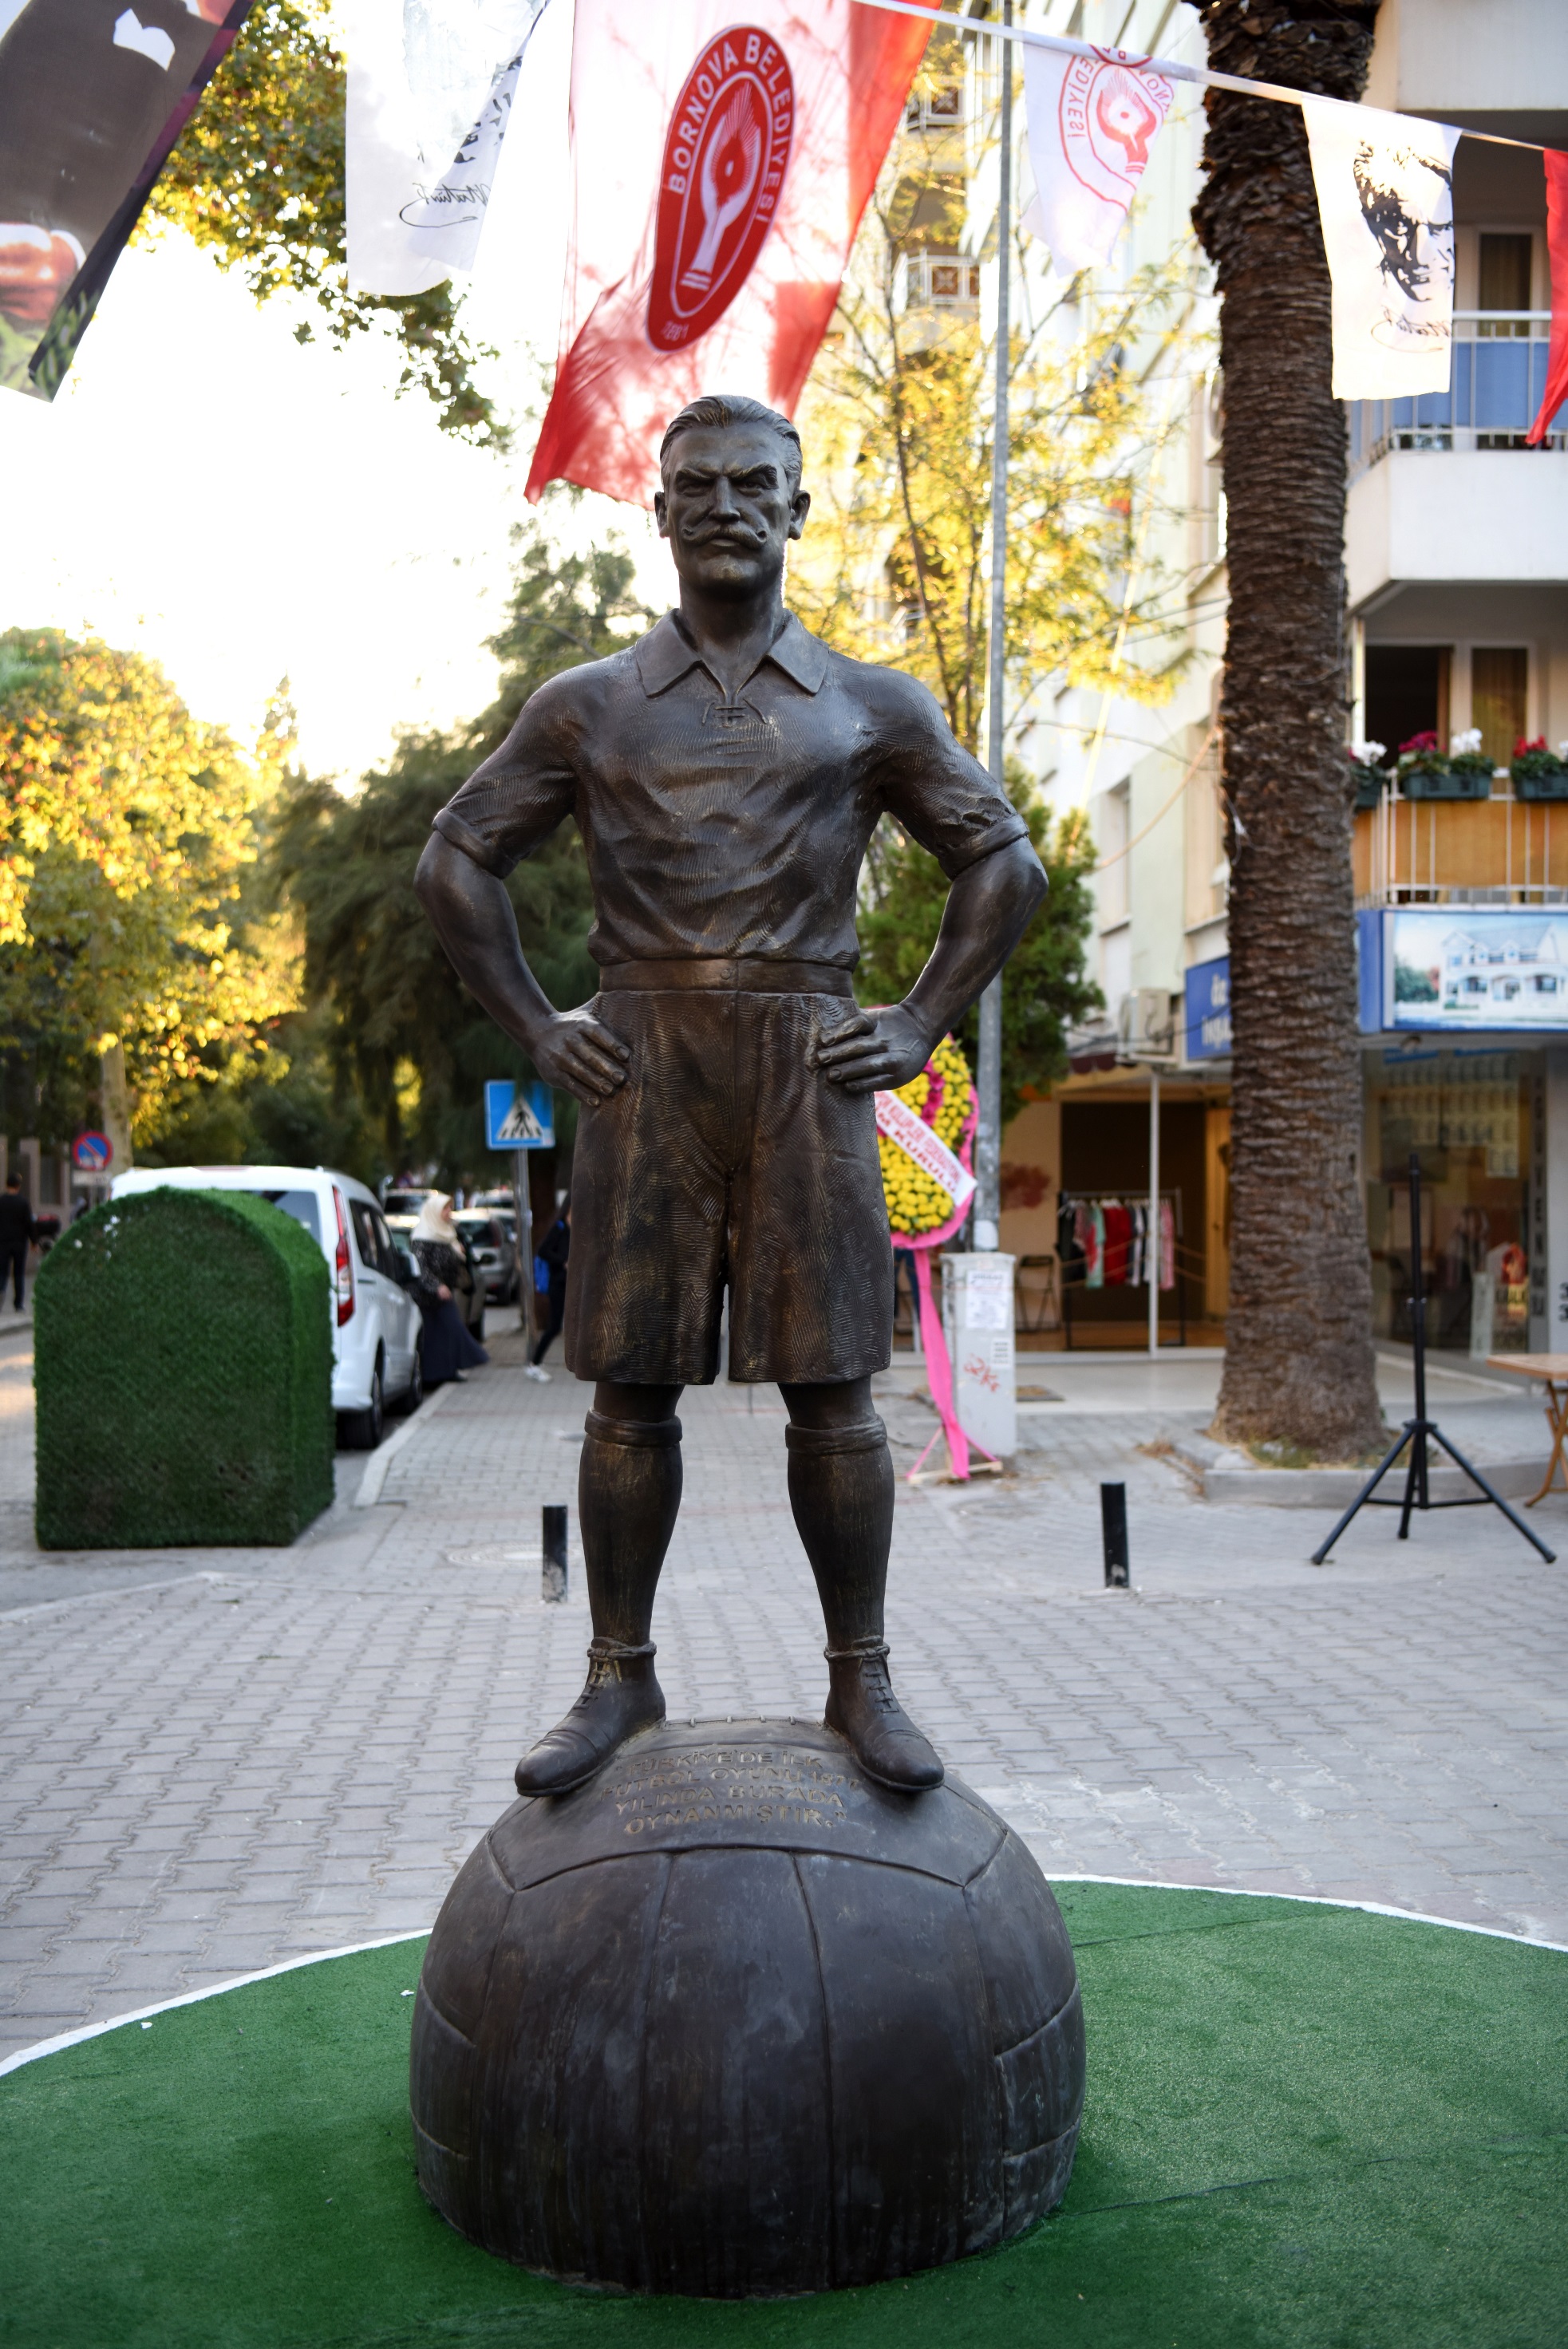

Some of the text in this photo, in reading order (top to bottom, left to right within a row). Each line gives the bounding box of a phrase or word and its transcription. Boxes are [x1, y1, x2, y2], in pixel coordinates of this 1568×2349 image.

[669, 41, 739, 195] BORNOVA
[783, 1750, 823, 1769] İLK
[600, 1767, 859, 1801] FUTBOL OYUNU 1877
[615, 1784, 844, 1816] YILINDA BURADA
